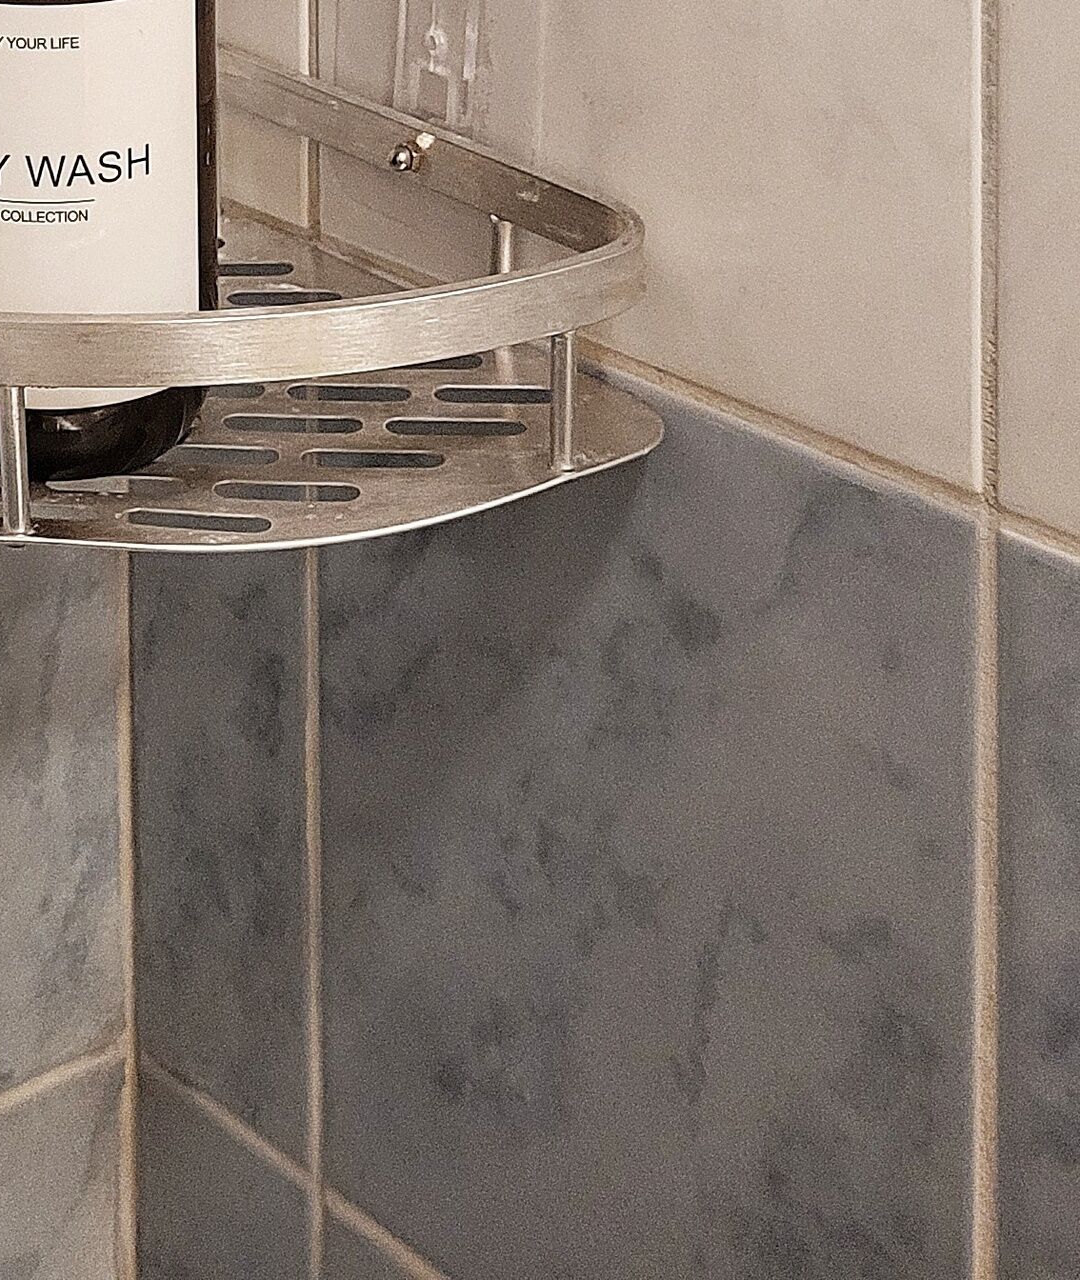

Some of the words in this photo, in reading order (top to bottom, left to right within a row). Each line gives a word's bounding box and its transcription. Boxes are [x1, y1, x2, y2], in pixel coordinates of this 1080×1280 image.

[6, 36, 48, 50] YOUR
[50, 36, 80, 50] LIFE
[24, 143, 150, 188] WASH
[0, 209, 89, 224] COLLECTION
